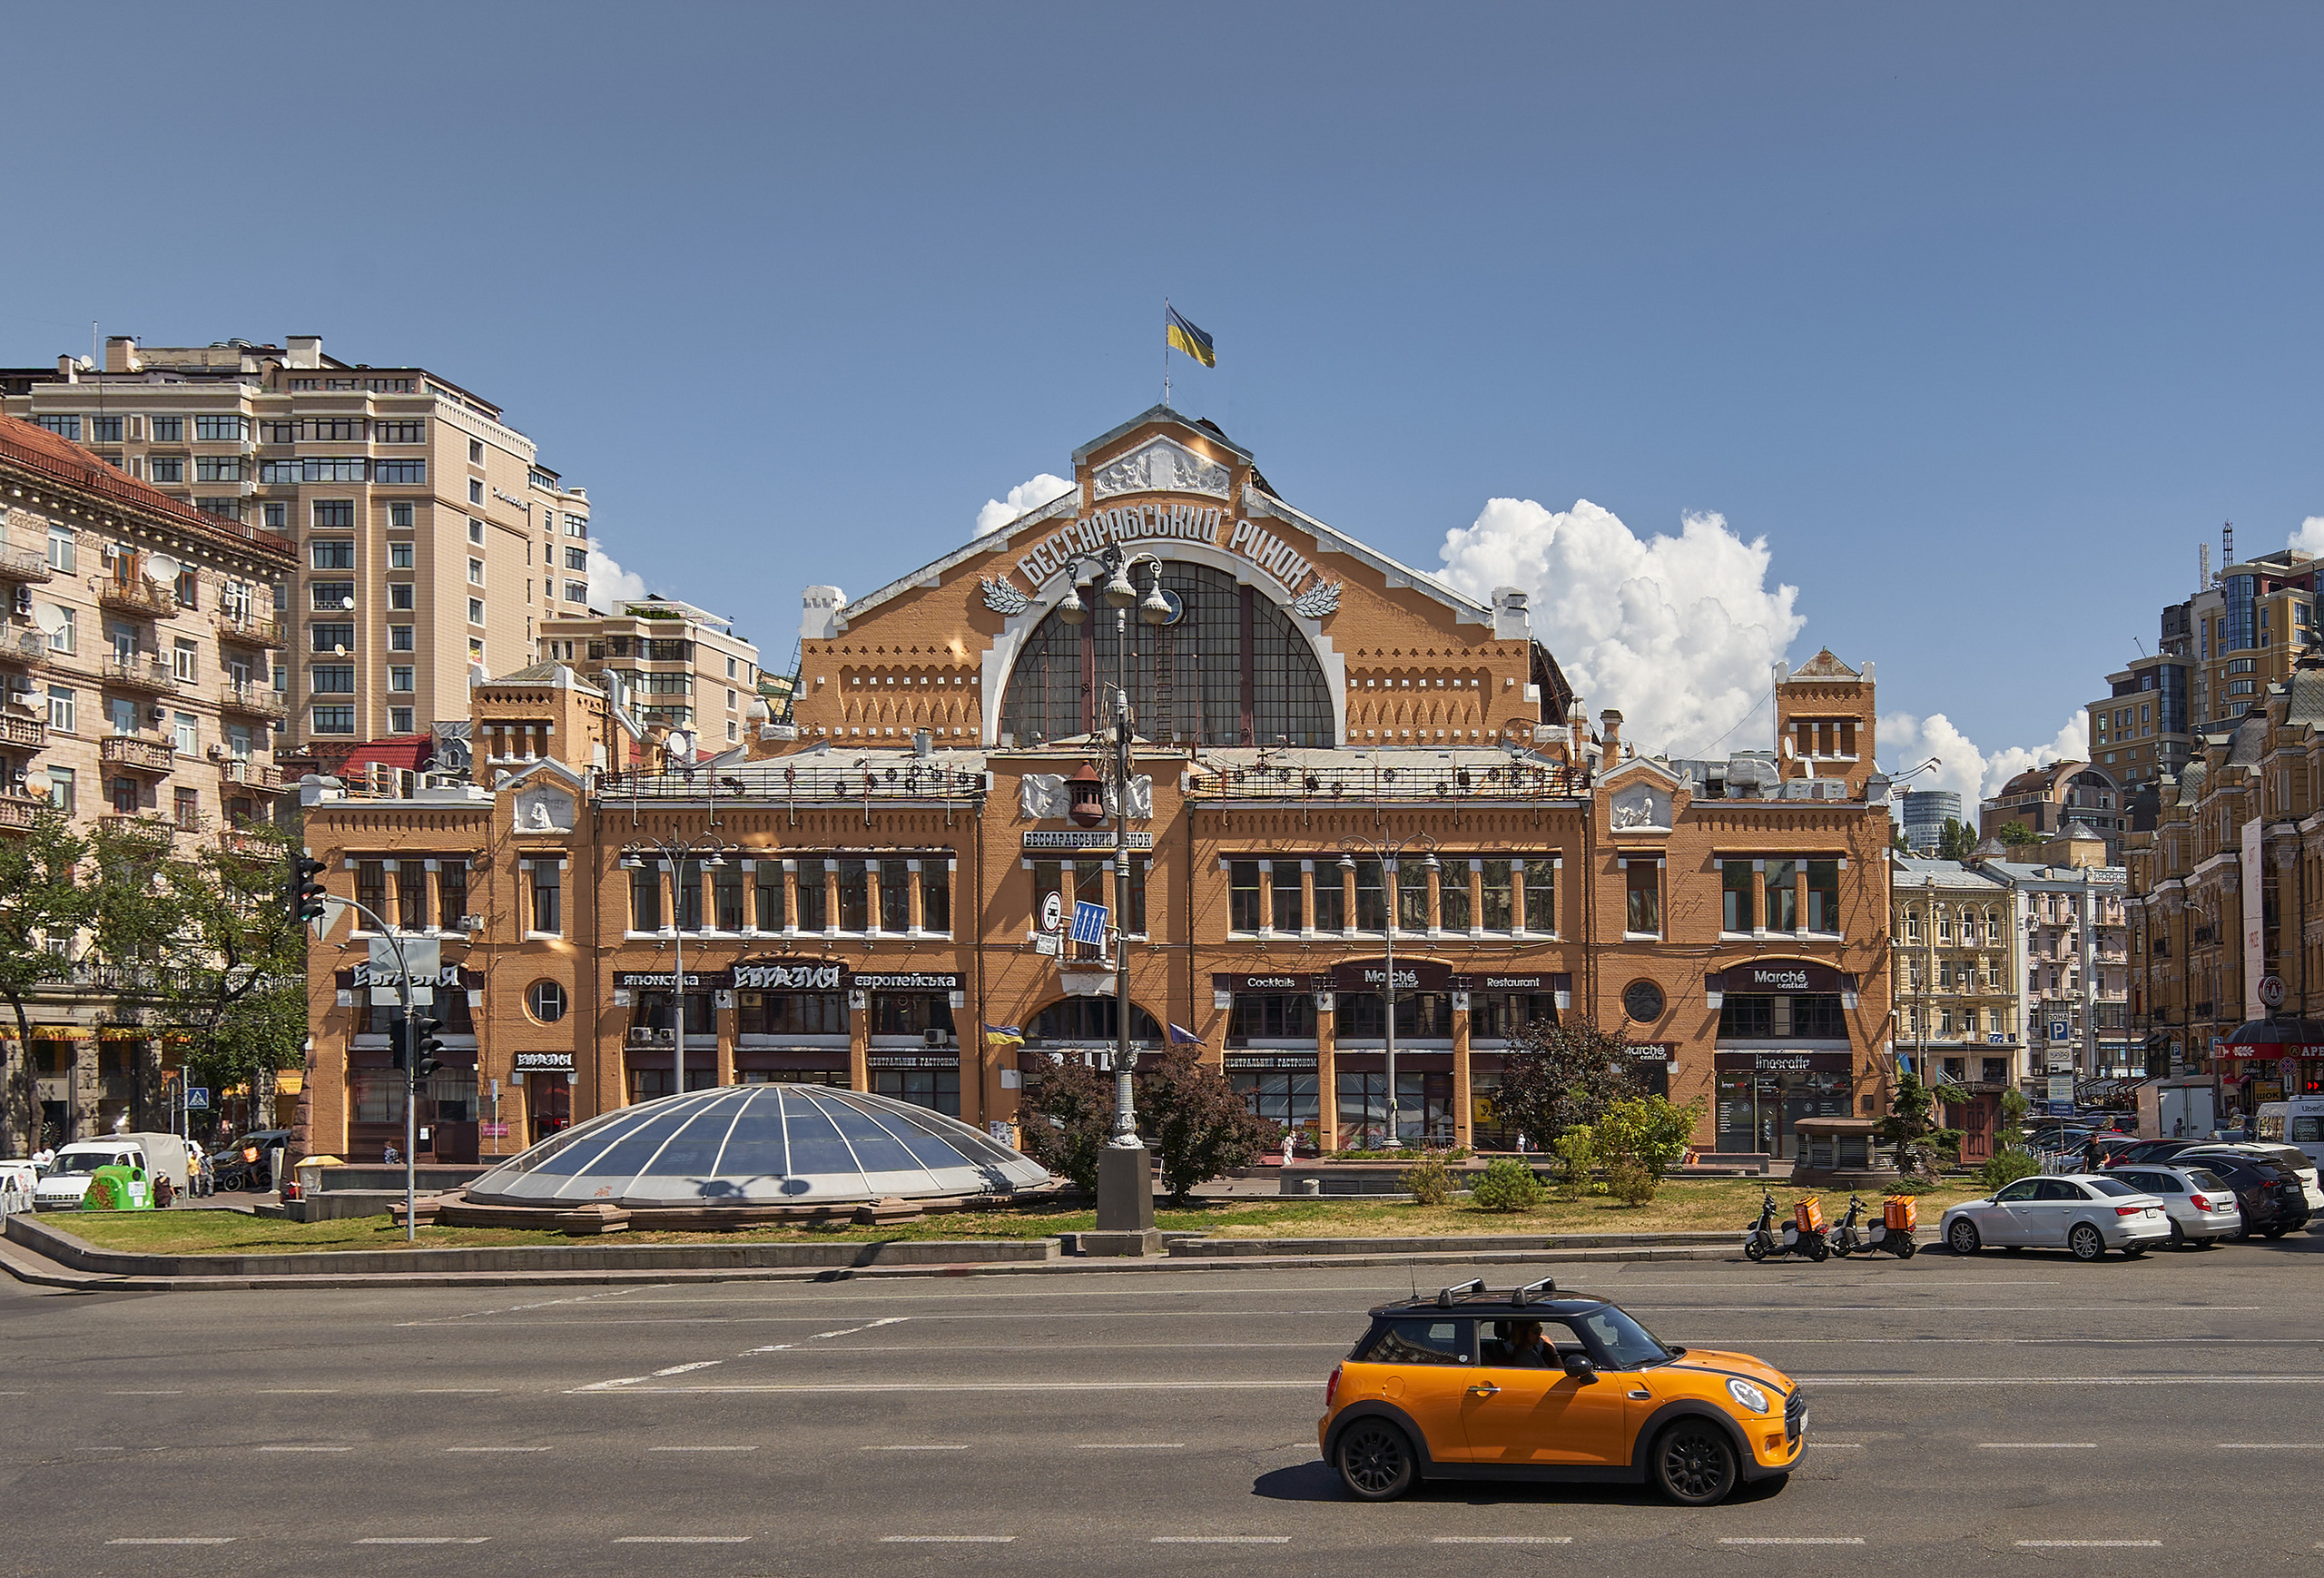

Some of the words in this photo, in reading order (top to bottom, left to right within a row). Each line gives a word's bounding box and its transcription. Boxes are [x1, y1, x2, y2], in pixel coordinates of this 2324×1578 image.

[1017, 504, 1222, 587] БЕССАРАБСЬКИЙ
[1229, 519, 1313, 589] РИНОК
[1025, 833, 1113, 846] БЕССАРАБСЬКИЙ
[1126, 833, 1151, 846] НОК
[352, 965, 459, 987] ЕВРЗИЯ
[733, 965, 841, 989] ЕВРАЗИЯ
[854, 972, 957, 989] європейська
[1247, 977, 1295, 987] Cocktails
[1364, 969, 1417, 982] Maché
[1486, 976, 1541, 987] Restaurant
[1754, 970, 1807, 983] Marché
[1392, 980, 1420, 989] entral
[1777, 981, 1810, 990] central
[2053, 1022, 2065, 1040] P
[517, 1053, 572, 1066] ЕВРАЗИЯ
[920, 1057, 959, 1067] ГАСТРОНОМ
[1277, 1058, 1317, 1068] ГАСТРОНОМ
[2256, 1091, 2280, 1100] ШОК
